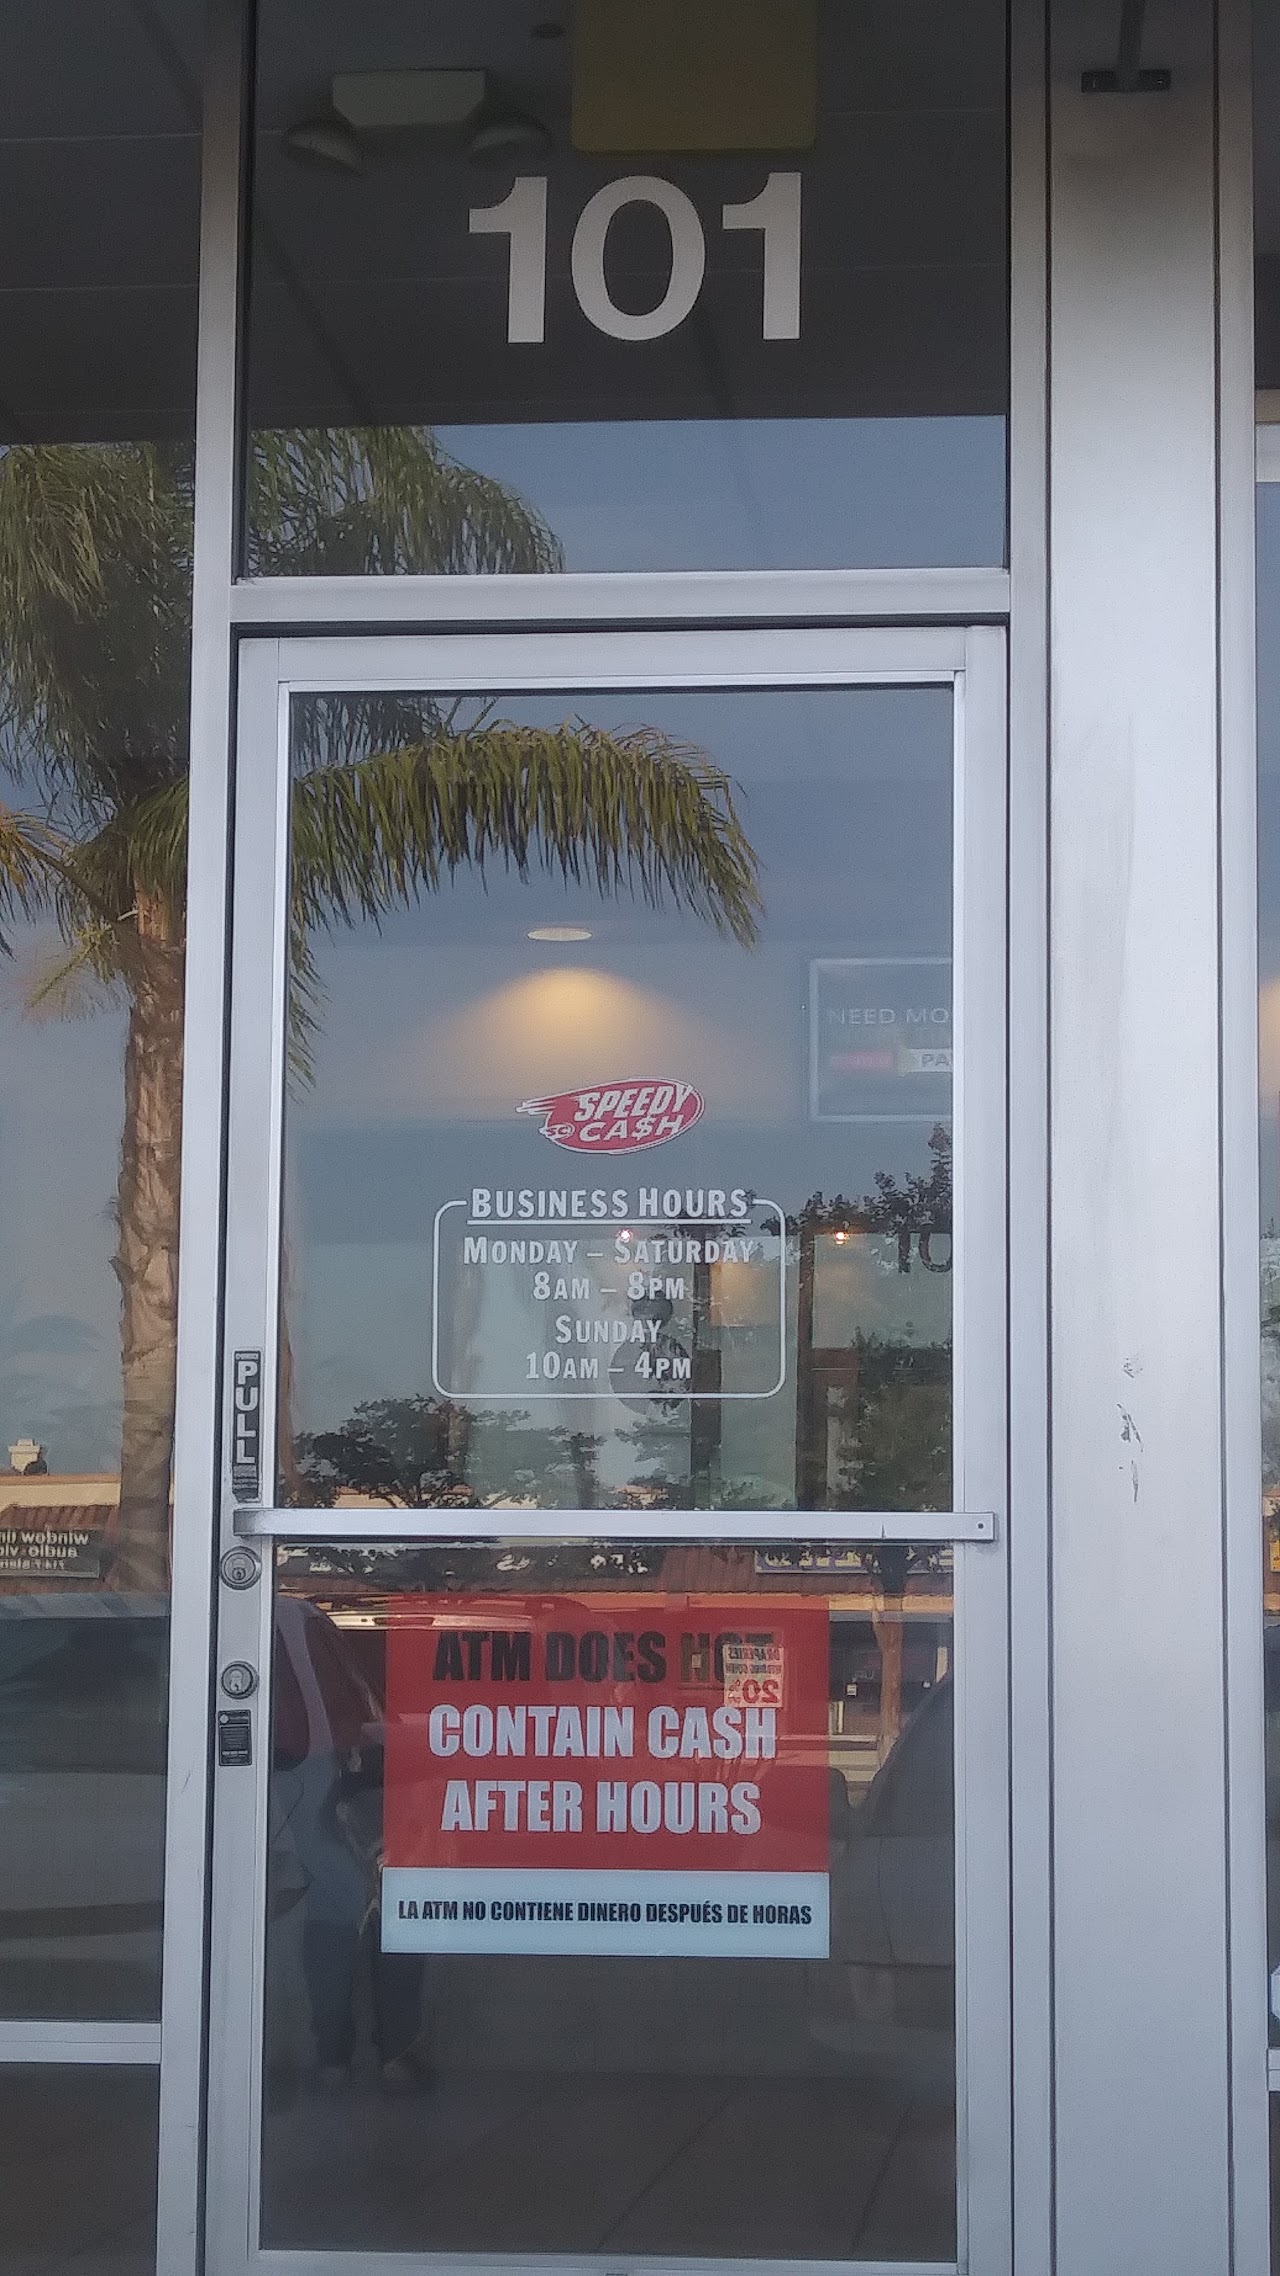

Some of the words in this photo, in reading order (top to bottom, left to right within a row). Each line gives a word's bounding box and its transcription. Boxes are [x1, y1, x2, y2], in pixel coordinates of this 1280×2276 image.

[469, 172, 802, 344] 101
[827, 1008, 897, 1025] NEED
[574, 1083, 693, 1122] SPEEDY
[472, 1187, 629, 1218] BUSINESS
[638, 1187, 748, 1218] HOURS
[463, 1237, 578, 1265] MONDAY
[614, 1238, 753, 1265] SATURDAY
[533, 1271, 590, 1301] 8AM
[627, 1271, 685, 1300] 8PM
[555, 1315, 662, 1344] SUNDAY
[526, 1352, 599, 1380] 10AM
[634, 1351, 692, 1380] 4PM
[235, 1360, 259, 1464] PULL
[433, 1631, 531, 1682] ATM
[545, 1631, 667, 1683] DOES
[428, 1704, 634, 1758] CONTAIN
[647, 1705, 777, 1759] CASH
[440, 1780, 583, 1834] AFTER
[596, 1780, 762, 1835] HOURS
[398, 1901, 419, 1920] LA
[422, 1901, 458, 1920] ATM
[462, 1901, 486, 1921] NO
[490, 1901, 574, 1921] CONTIENE
[577, 1902, 641, 1922] DINERO
[646, 1900, 723, 1923] DESPUÉS
[727, 1904, 748, 1924] DE
[753, 1904, 813, 1925] HORAS
